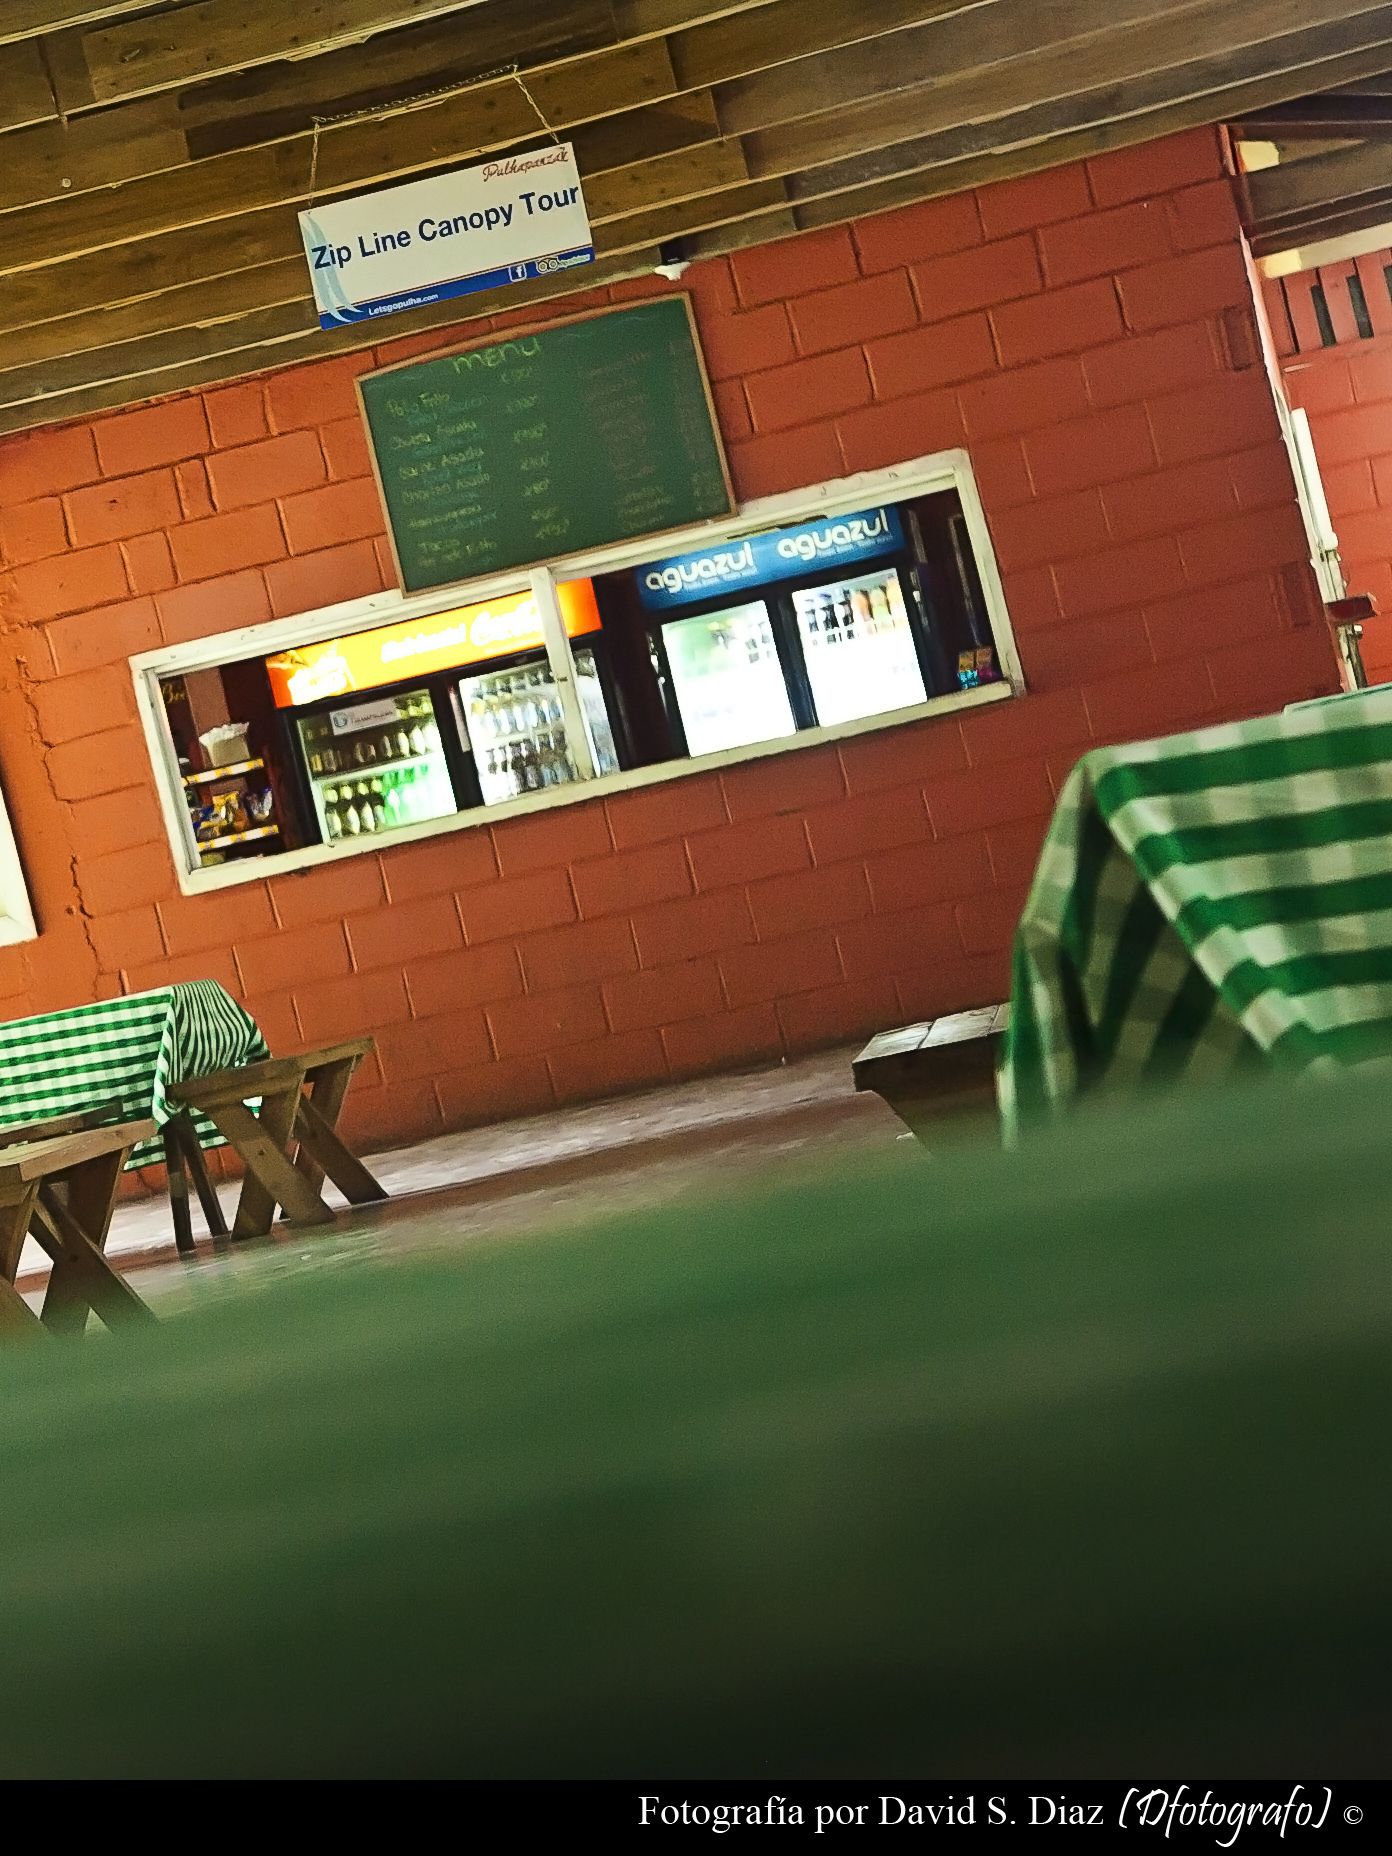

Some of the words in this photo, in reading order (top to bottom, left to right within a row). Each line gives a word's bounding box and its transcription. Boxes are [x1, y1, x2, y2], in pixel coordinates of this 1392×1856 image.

[311, 244, 351, 269] Zip
[358, 230, 411, 257] Line
[419, 203, 513, 241] Canopy
[519, 186, 579, 215] Tour
[368, 293, 439, 316] Letsgopulha.com
[645, 541, 755, 593] aguazul
[777, 509, 890, 560] aguazul
